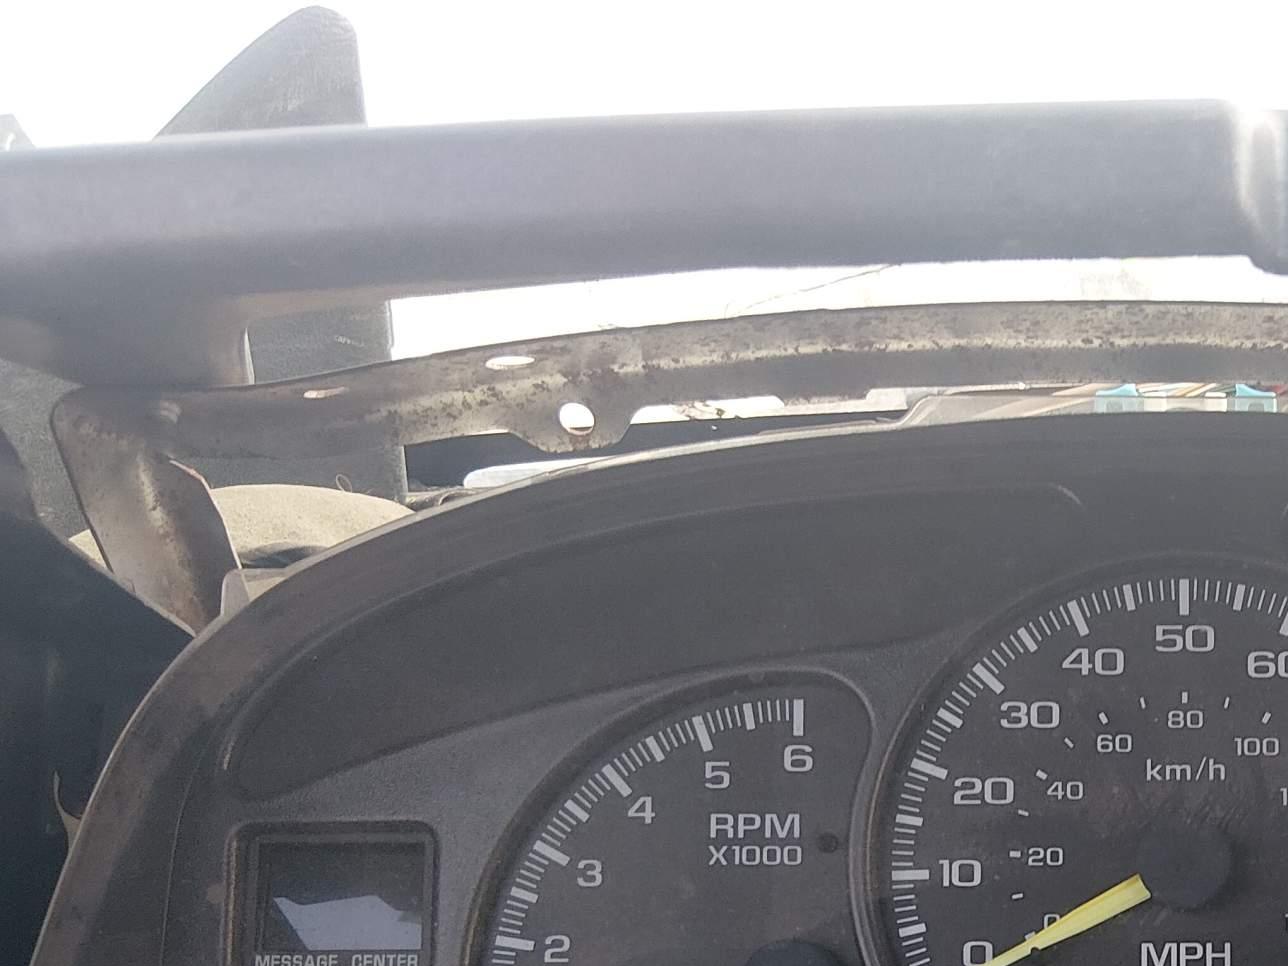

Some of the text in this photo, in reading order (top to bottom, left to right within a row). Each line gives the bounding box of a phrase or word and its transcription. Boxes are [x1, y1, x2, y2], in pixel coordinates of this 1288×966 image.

[1154, 625, 1215, 652] 50
[1062, 648, 1124, 676] 40
[1000, 702, 1060, 729] 30
[1167, 710, 1204, 729] 80
[1097, 734, 1133, 753] 60
[1235, 737, 1280, 757] 100
[783, 745, 813, 772] 6
[1146, 759, 1226, 783] km/h
[703, 760, 731, 791] 5
[954, 777, 1014, 805] 20
[1047, 781, 1084, 800] 40
[628, 797, 656, 824] 4
[709, 813, 801, 838] RPM
[708, 845, 803, 866] X1000
[1028, 848, 1064, 867] 20
[577, 860, 603, 887] 3
[939, 859, 982, 887] 10
[544, 937, 571, 963] 2
